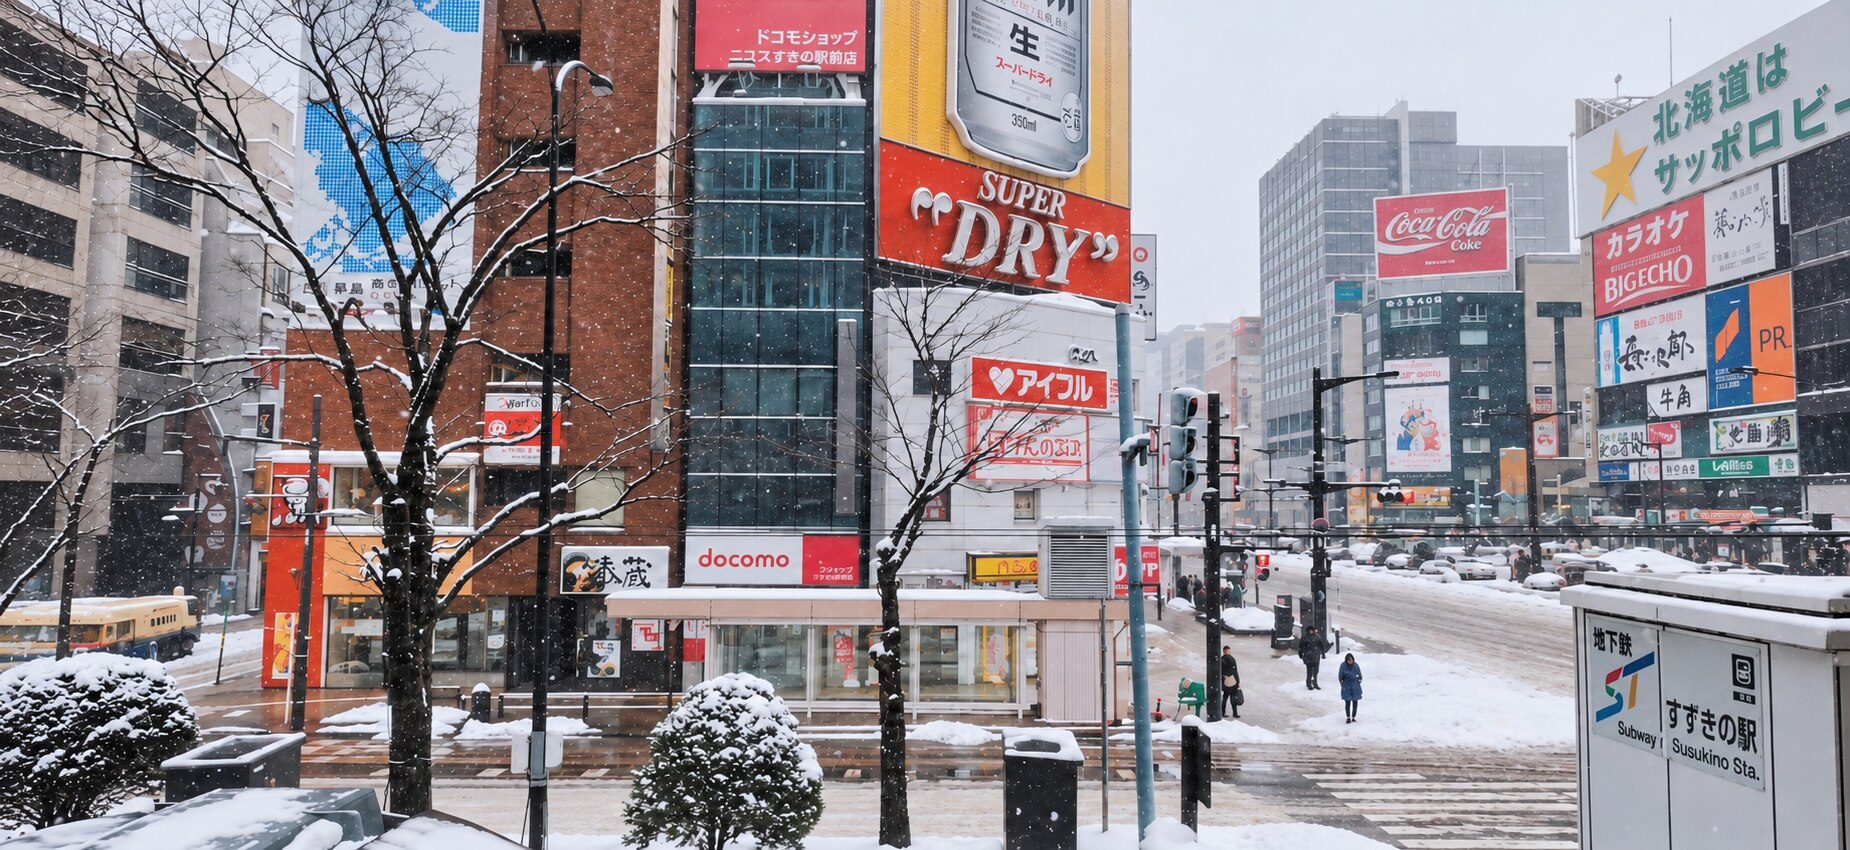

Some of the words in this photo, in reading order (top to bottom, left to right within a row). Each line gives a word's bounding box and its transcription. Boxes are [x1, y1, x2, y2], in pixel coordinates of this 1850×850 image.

[757, 29, 858, 46] ドコモショップ
[1009, 22, 1040, 62] 生
[995, 56, 1053, 88] スーパードライ
[1653, 42, 1787, 146] 北海道は
[1011, 113, 1037, 133] 350ml
[977, 170, 1067, 219] SUPER
[1385, 205, 1494, 242] Coca-Cola
[1606, 209, 1689, 260] カラオケ
[1450, 239, 1482, 252] Coke
[1016, 368, 1093, 402] アイフル
[1660, 383, 1691, 412] 牛角
[698, 548, 790, 568] docomo
[1618, 720, 1657, 749] Subway
[1672, 738, 1729, 770] Susukino
[1733, 757, 1760, 781] Sta.
